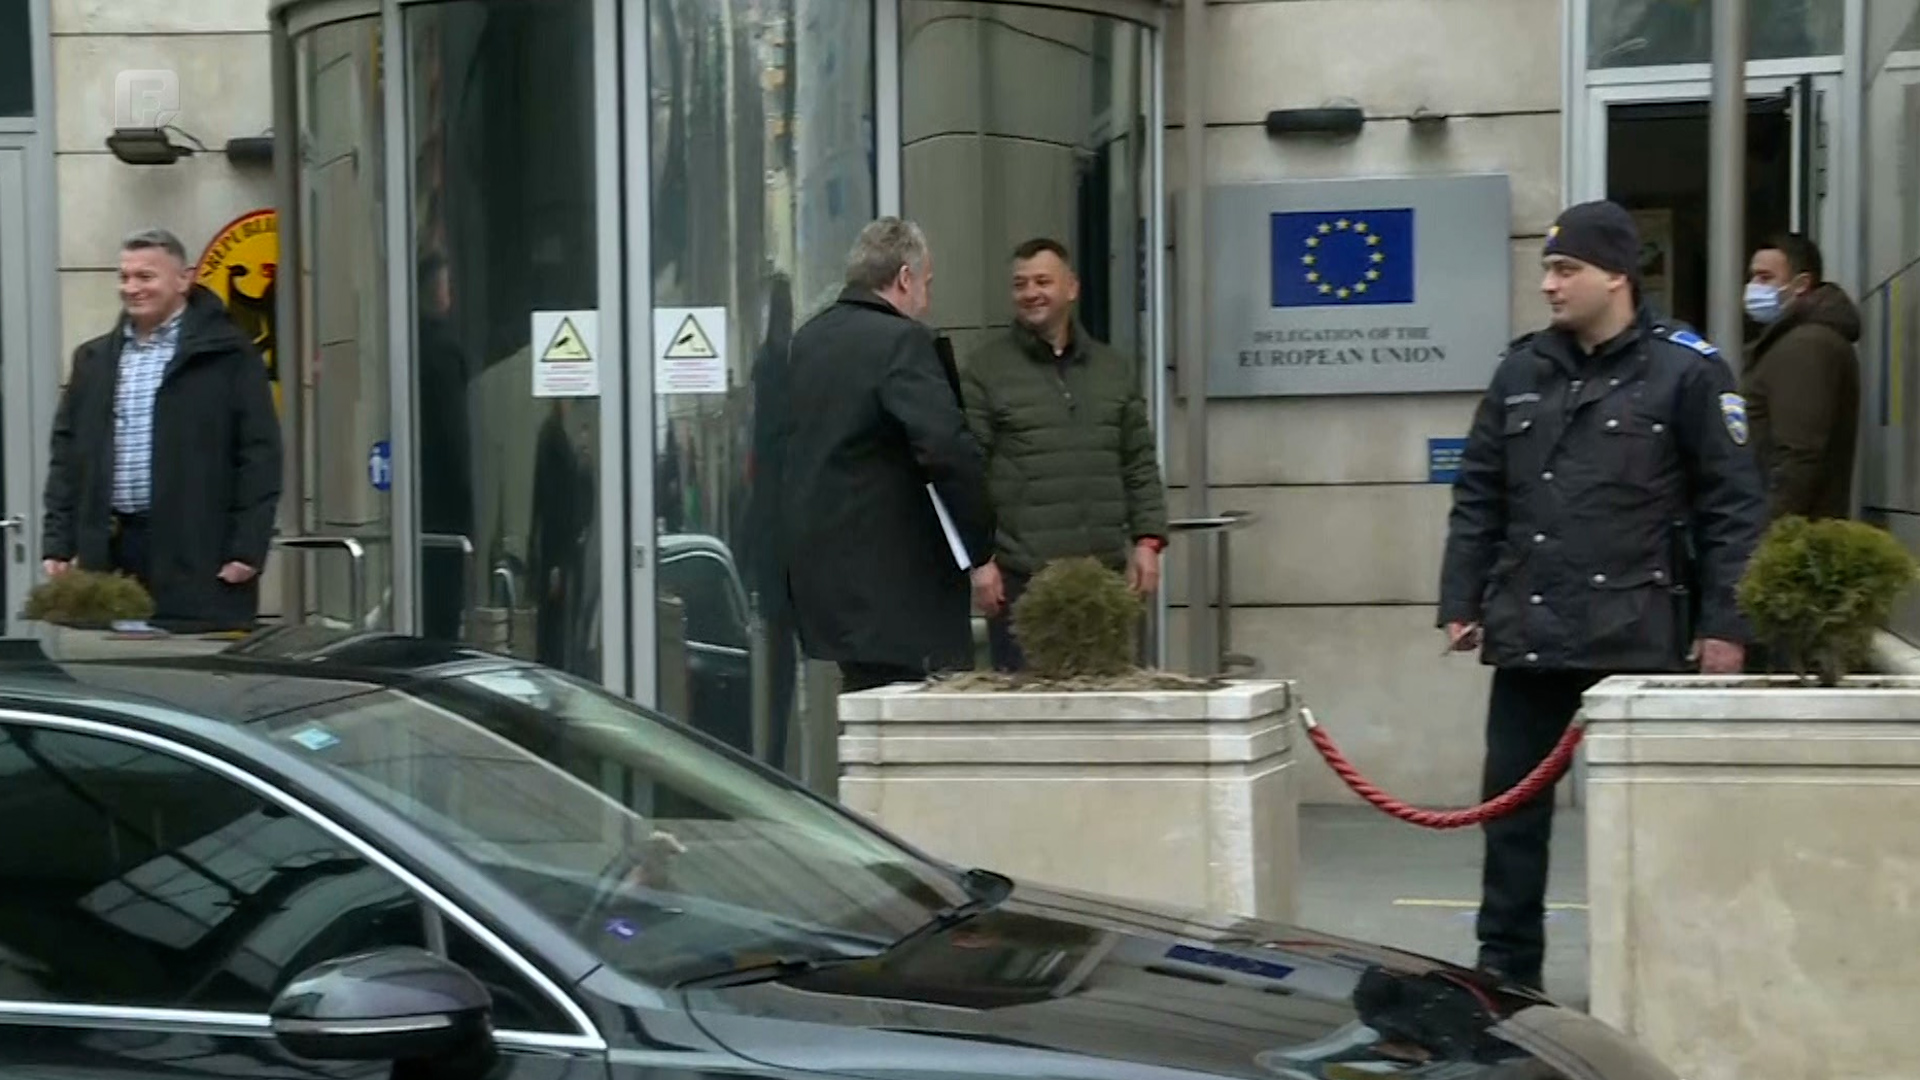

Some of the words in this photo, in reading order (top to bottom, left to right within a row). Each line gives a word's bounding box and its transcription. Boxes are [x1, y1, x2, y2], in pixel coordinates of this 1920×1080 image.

[1253, 328, 1364, 344] DELEGATION
[1368, 327, 1391, 341] OF
[1397, 326, 1430, 341] THE
[1239, 348, 1363, 367] EUROPEAN
[1371, 346, 1446, 365] UNION
